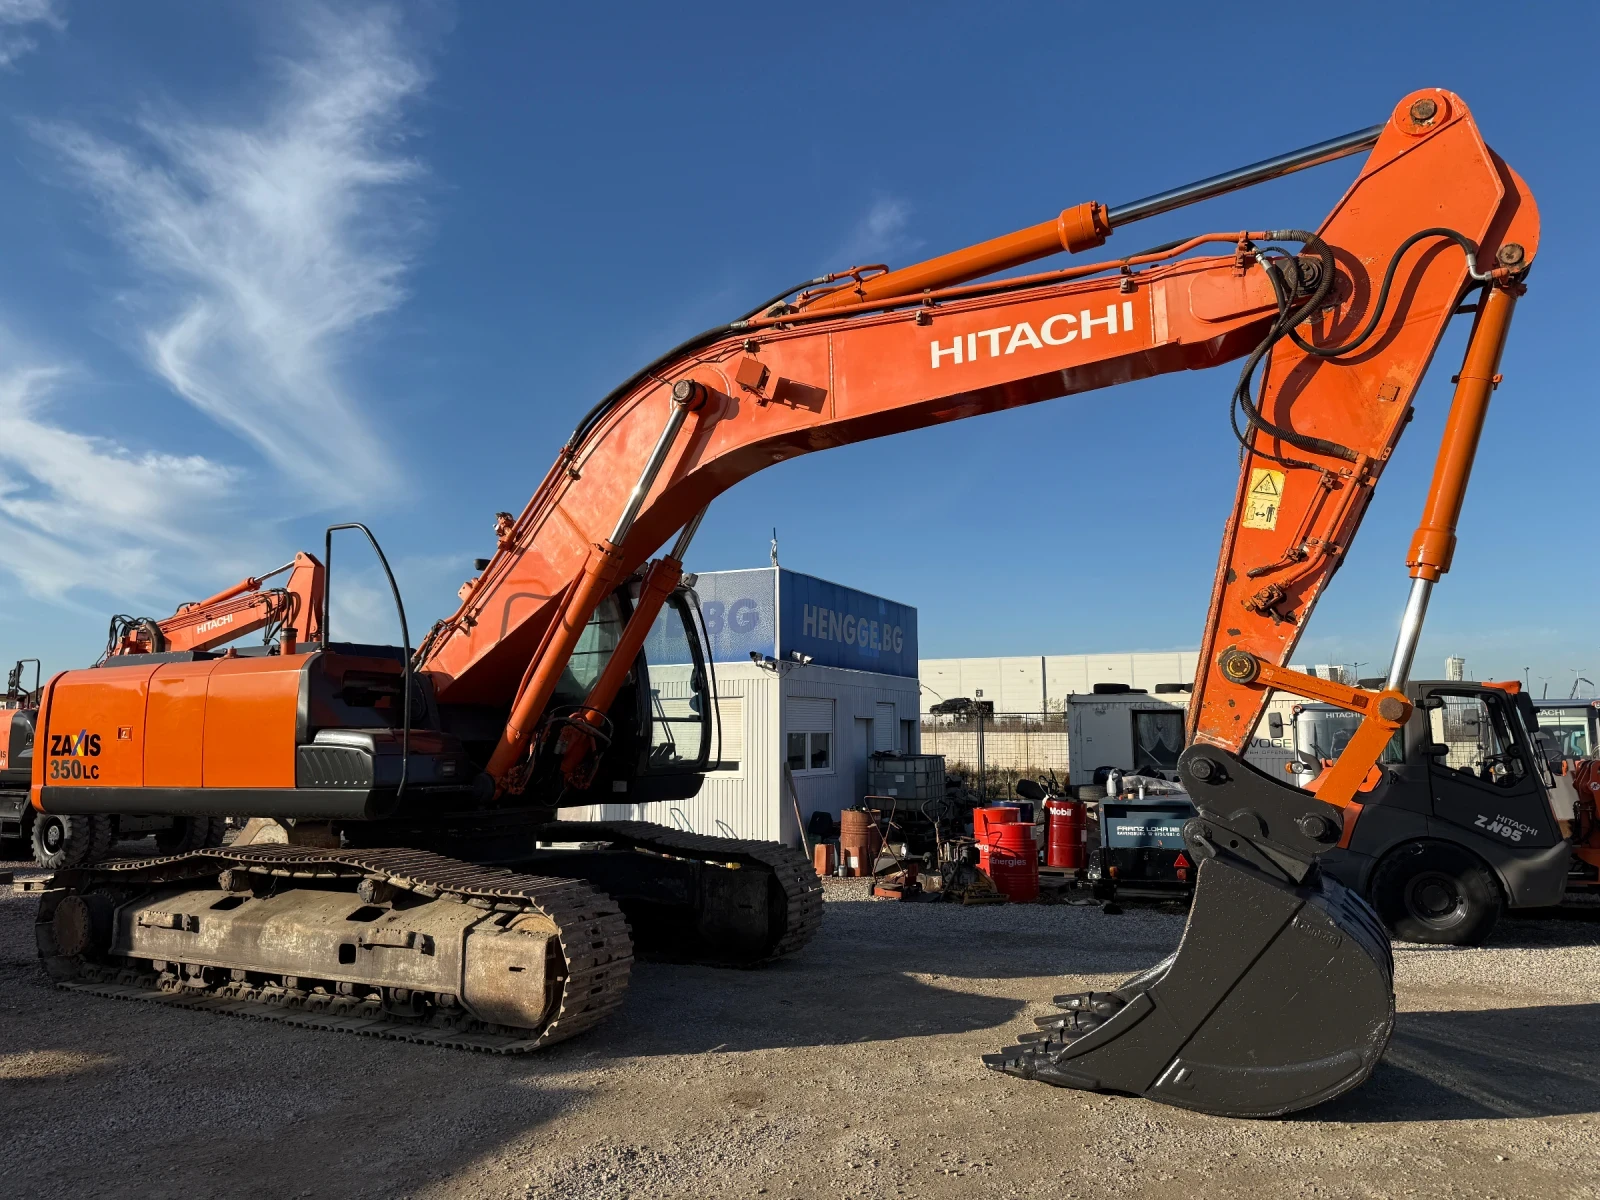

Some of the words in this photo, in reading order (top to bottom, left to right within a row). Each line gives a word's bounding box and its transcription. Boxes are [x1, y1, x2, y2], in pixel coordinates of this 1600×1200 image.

[930, 301, 1134, 369] HITACHI
[197, 613, 233, 635] HITACHI
[803, 603, 903, 654] HENGGE.BG
[1325, 712, 1361, 720] HITACHI
[50, 729, 102, 757] ZAXIS
[1049, 807, 1072, 817] Mobil
[1474, 814, 1522, 842] ZW95
[1495, 813, 1539, 836] HITACHI
[991, 857, 1027, 868] Energies
